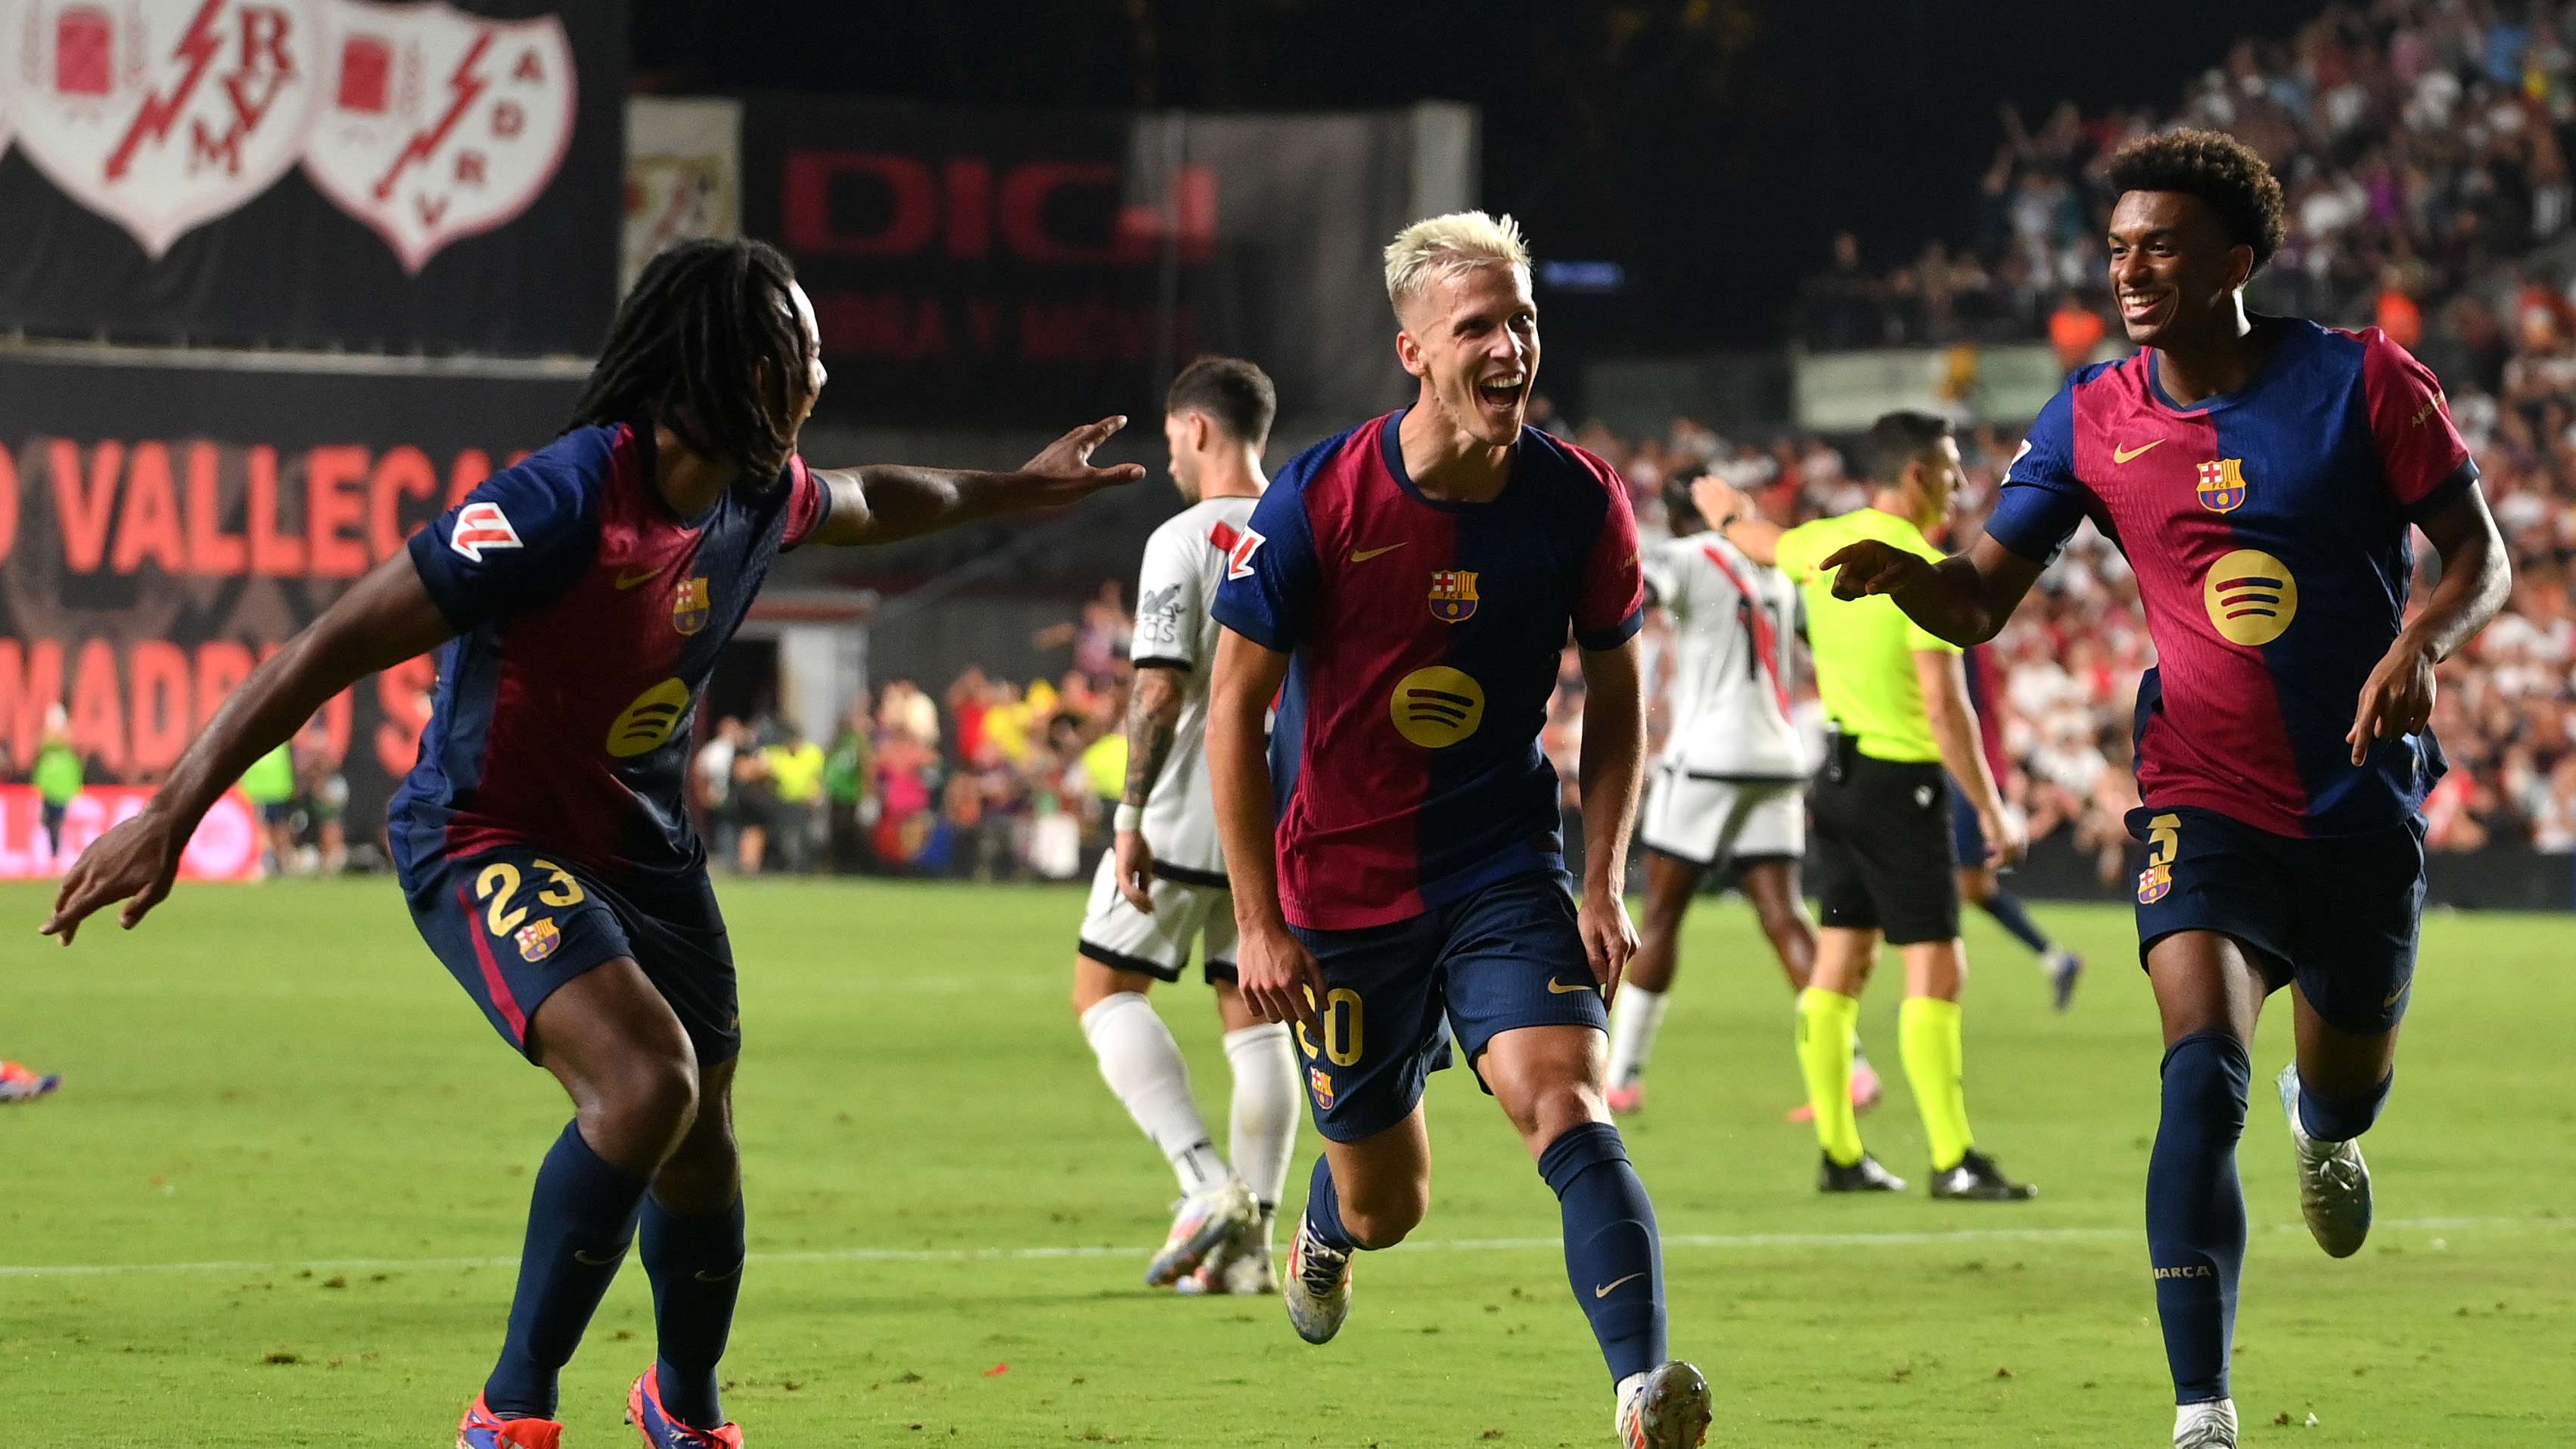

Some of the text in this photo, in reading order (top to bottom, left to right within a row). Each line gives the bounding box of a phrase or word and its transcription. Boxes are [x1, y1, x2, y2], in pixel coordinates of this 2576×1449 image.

[782, 151, 1218, 265] DIGI
[50, 437, 534, 577] VALLEC
[0, 637, 354, 772] MADR
[476, 859, 585, 937] 23
